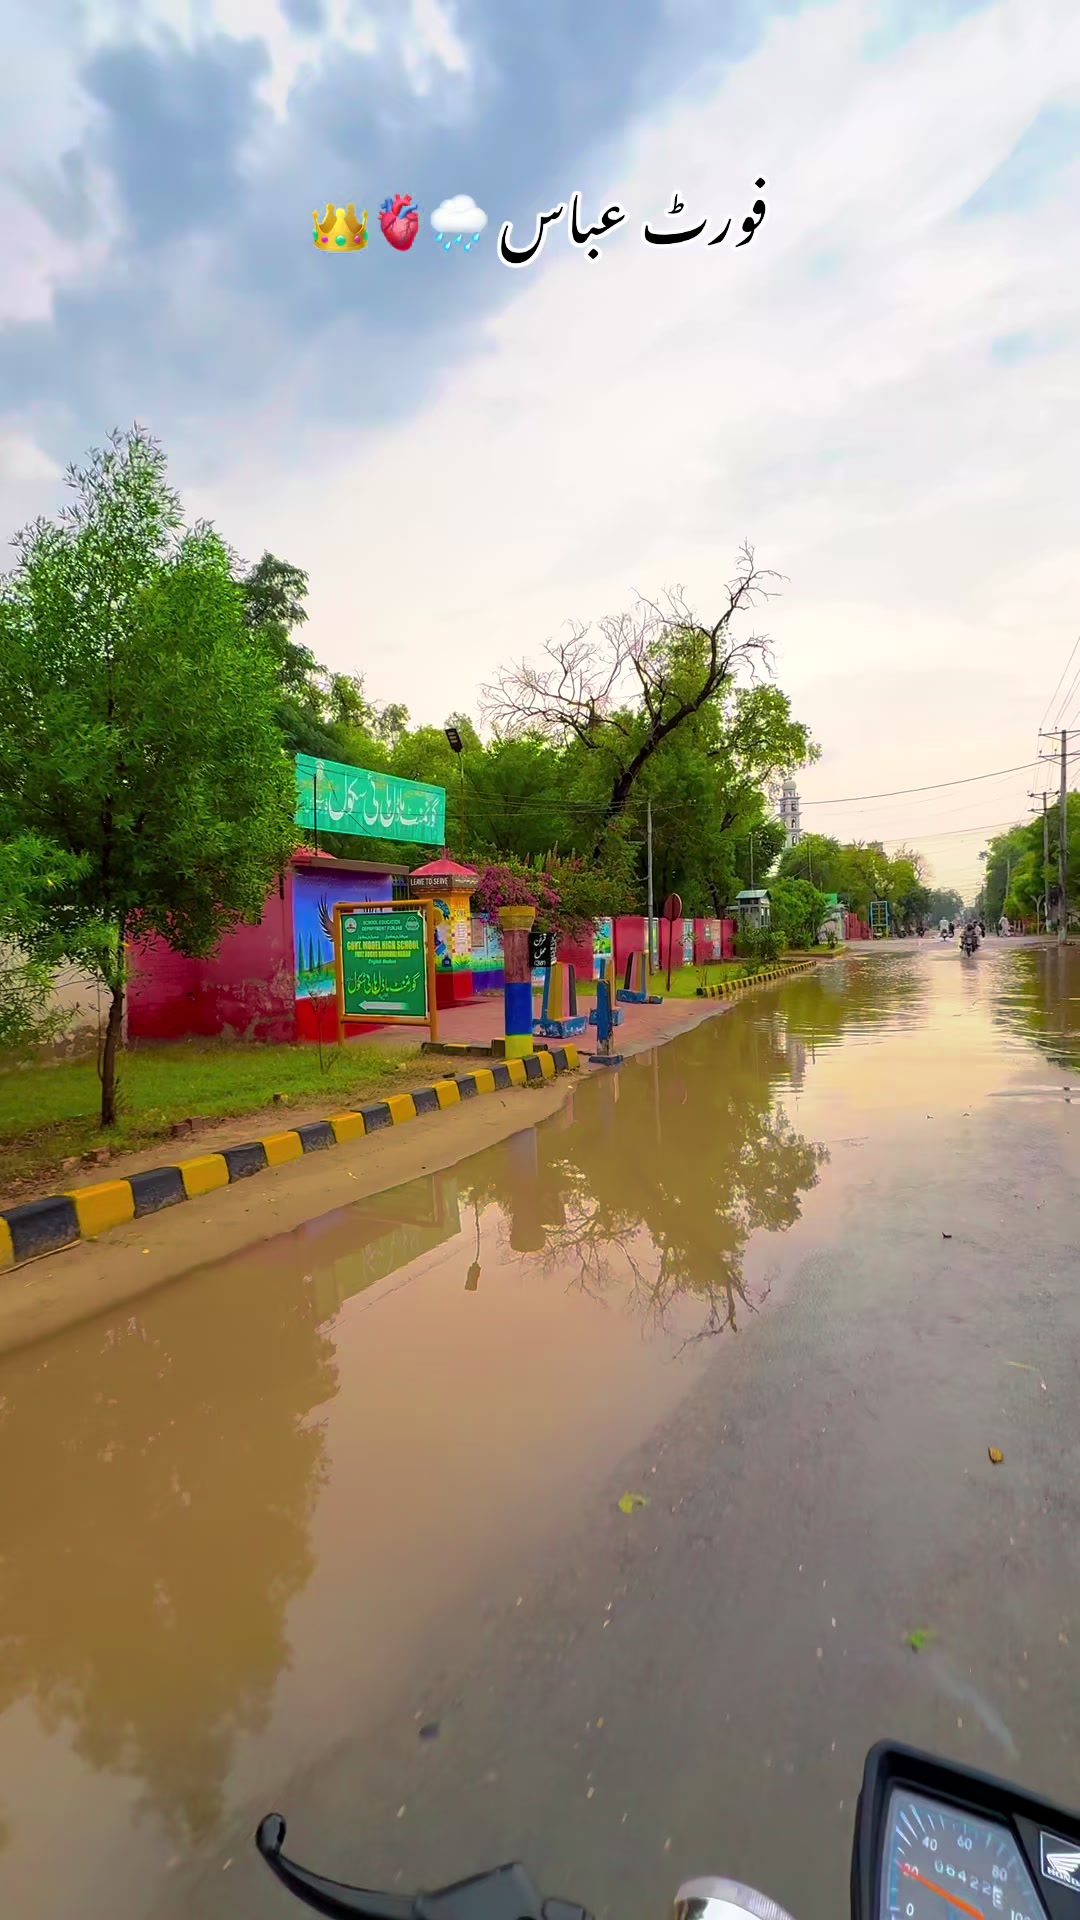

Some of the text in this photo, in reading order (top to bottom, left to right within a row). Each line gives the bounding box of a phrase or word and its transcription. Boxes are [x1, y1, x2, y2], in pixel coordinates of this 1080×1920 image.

[362, 941, 381, 950] MODEL
[381, 940, 396, 950] HIGH
[396, 939, 419, 949] SCHOOL
[922, 1836, 938, 1851] 40
[956, 1835, 973, 1851] 60
[991, 1865, 1008, 1882] 80
[1047, 1866, 1080, 1887] HOND
[906, 1902, 914, 1917] 0
